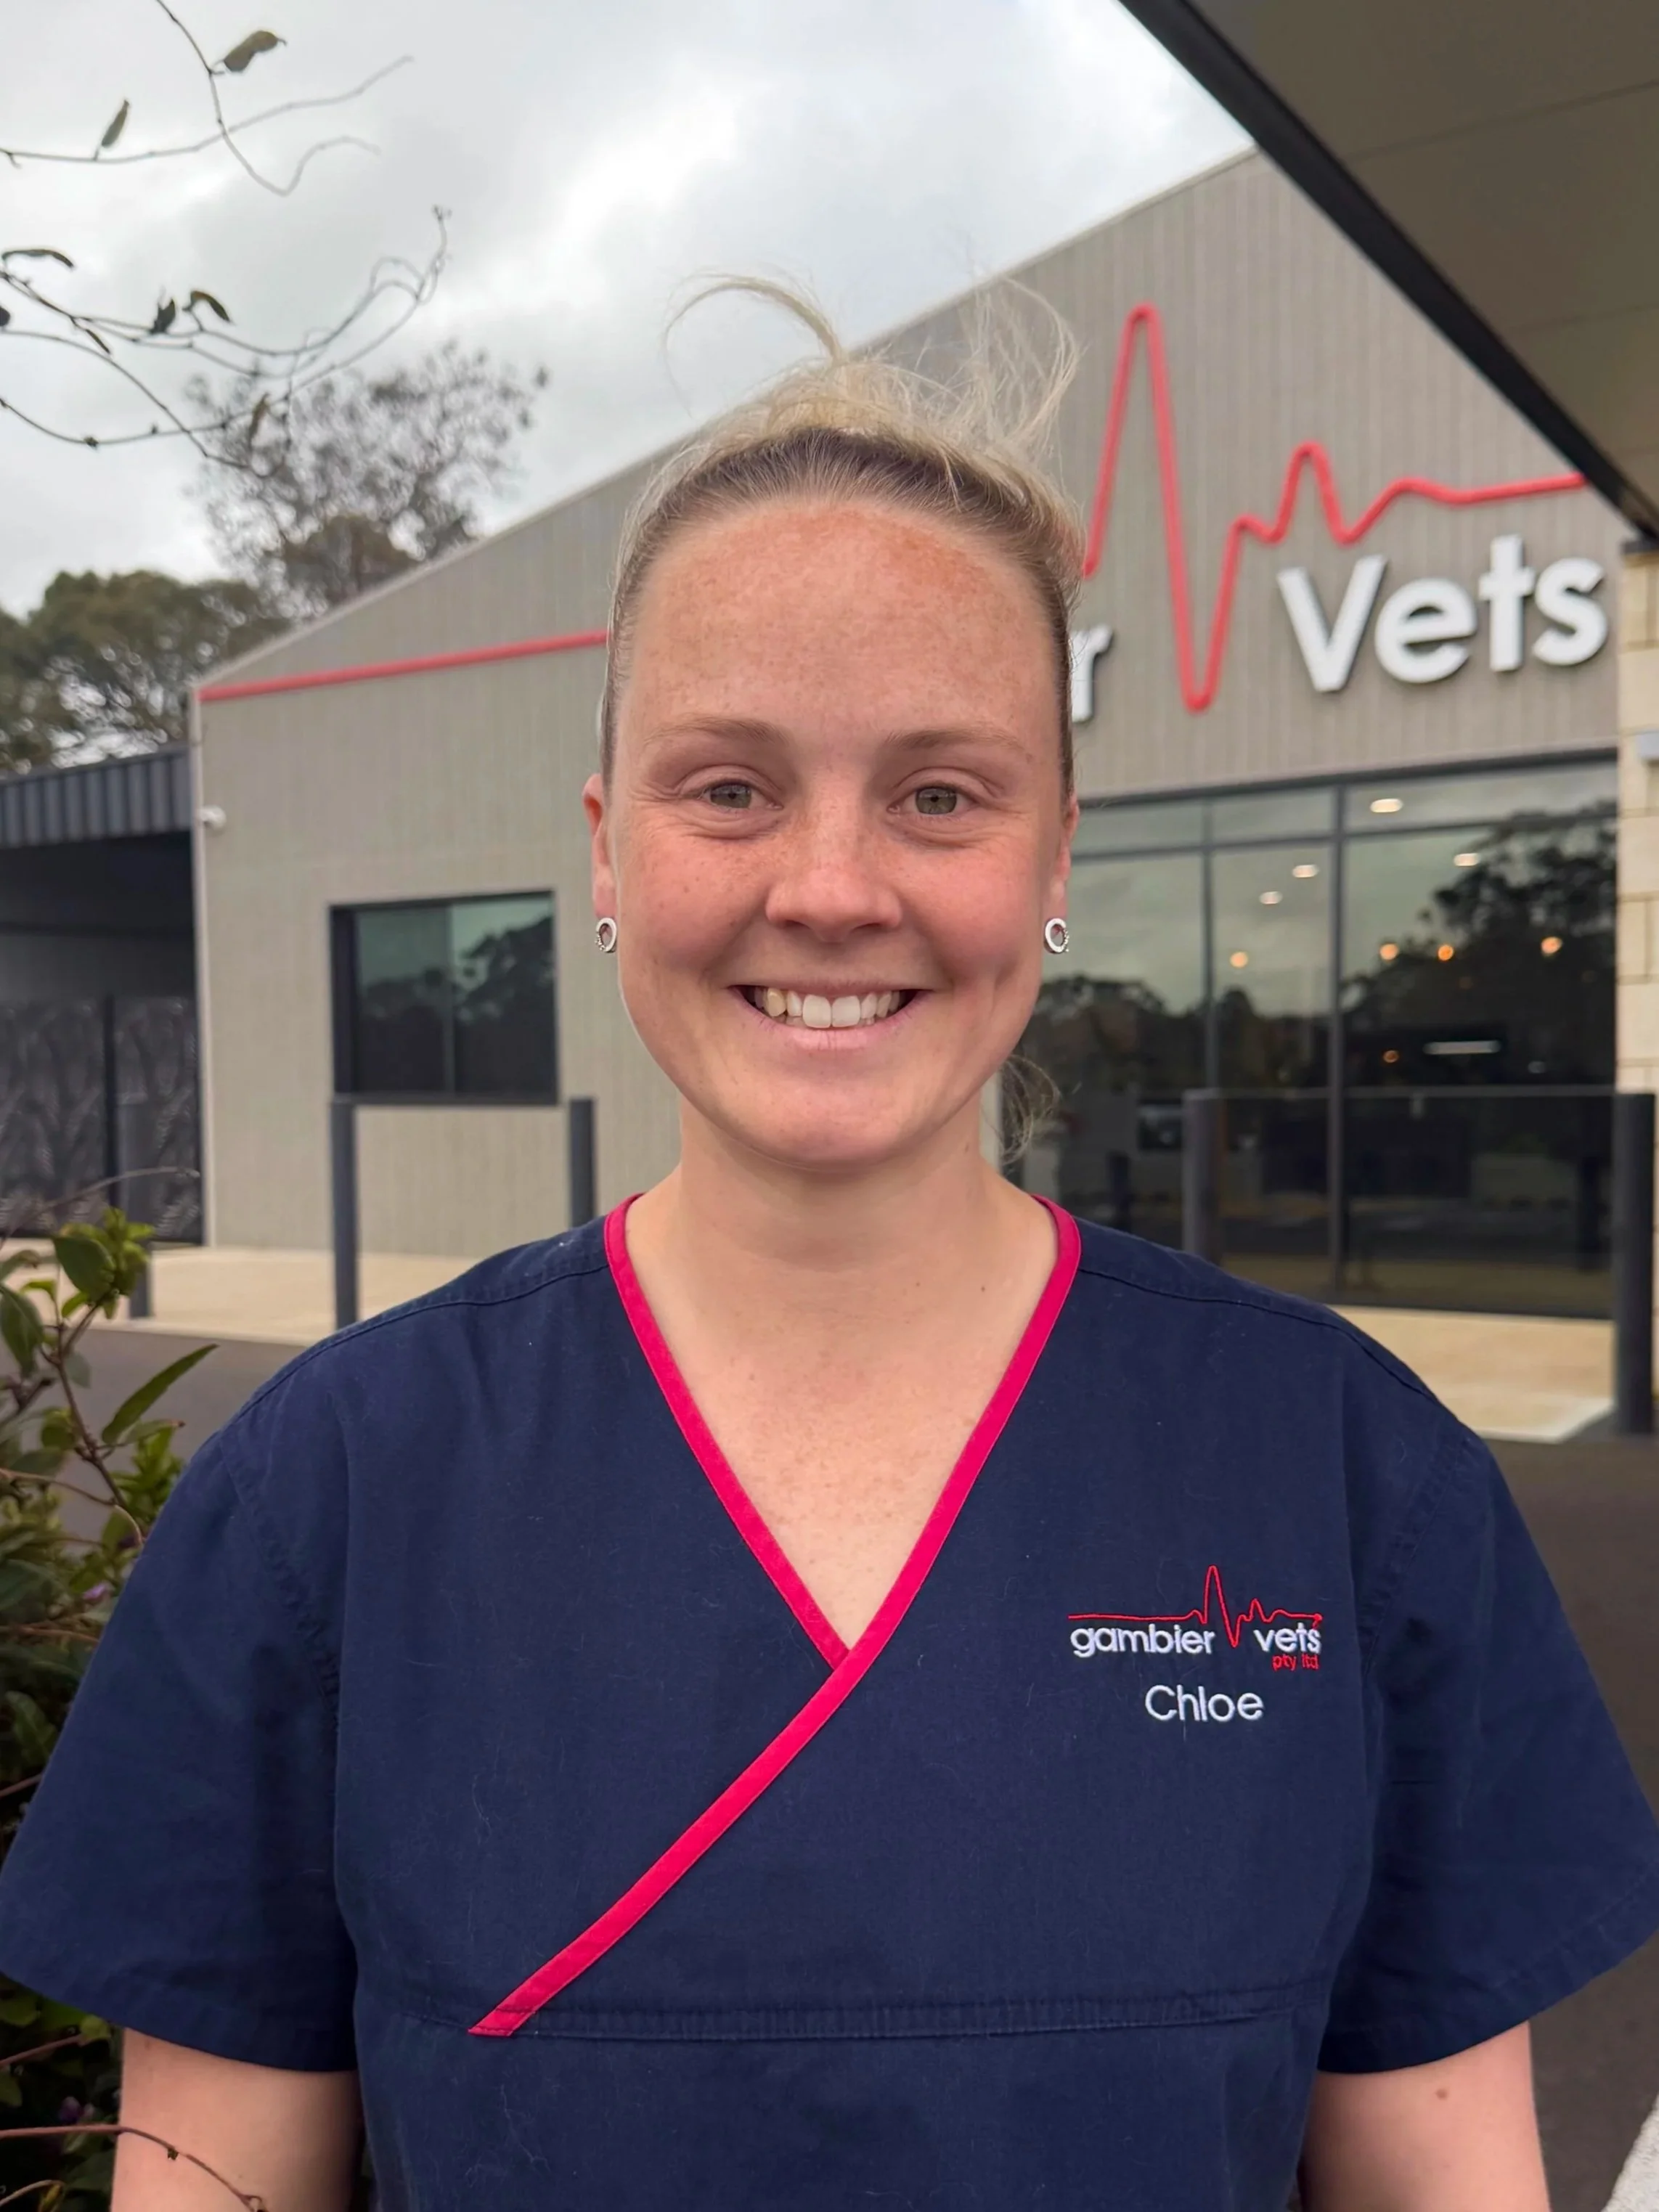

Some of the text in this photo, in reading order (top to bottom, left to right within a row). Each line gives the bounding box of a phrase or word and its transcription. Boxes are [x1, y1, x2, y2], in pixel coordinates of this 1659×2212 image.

[1276, 534, 1608, 693] Vets
[1070, 1622, 1321, 1658] gambier vets
[1271, 1654, 1296, 1671] pty
[1145, 1684, 1264, 1722] Chloe
